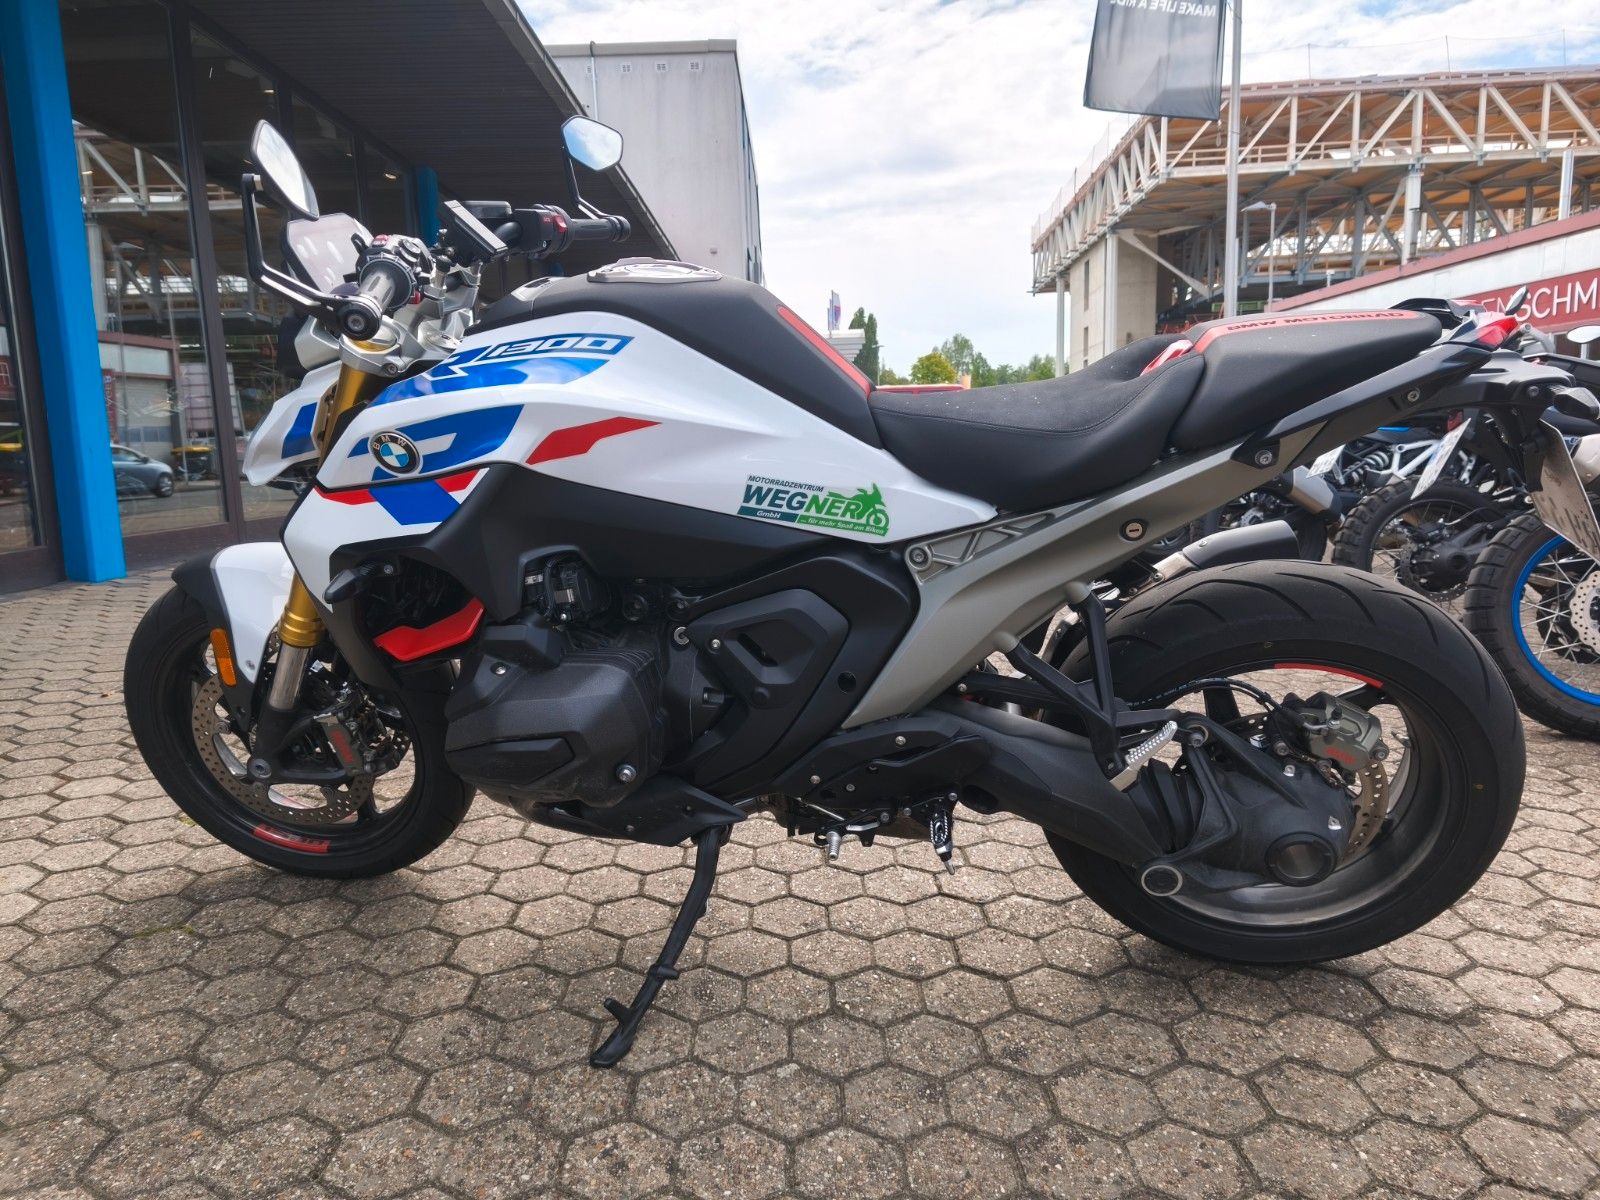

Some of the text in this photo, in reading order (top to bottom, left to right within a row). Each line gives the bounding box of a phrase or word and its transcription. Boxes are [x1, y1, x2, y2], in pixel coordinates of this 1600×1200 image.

[1227, 311, 1405, 331] BMW MOTORRAD
[486, 336, 622, 358] 1300
[373, 434, 407, 450] BMW
[747, 475, 825, 493] MOTORRADZENTRUM
[742, 483, 863, 520] WEGNER
[756, 510, 782, 519] GmbH
